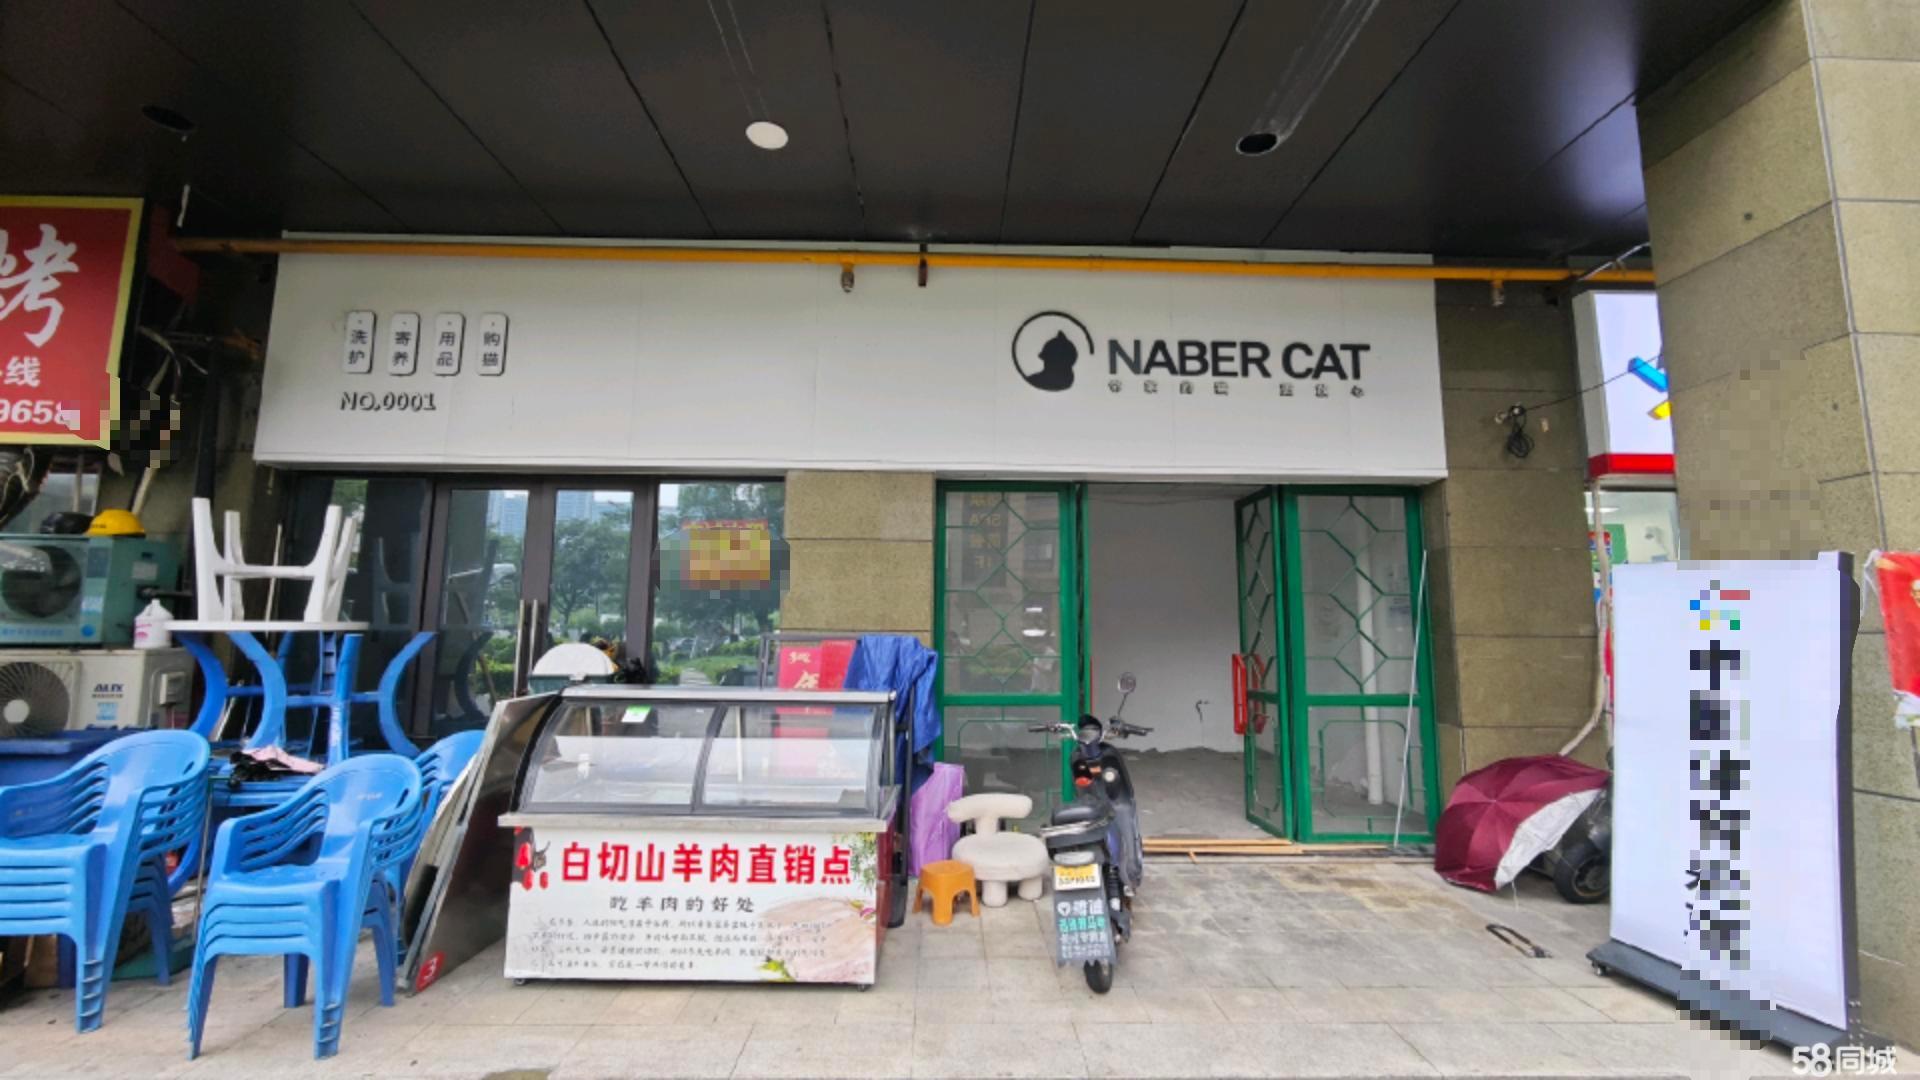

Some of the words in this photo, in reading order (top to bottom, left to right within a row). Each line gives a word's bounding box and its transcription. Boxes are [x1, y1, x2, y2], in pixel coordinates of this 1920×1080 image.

[348, 329, 368, 365] 洗护
[392, 330, 412, 367] 寄养
[436, 331, 456, 367] 用品
[482, 331, 501, 367] 购猫
[1107, 338, 1272, 379] NABER
[1280, 341, 1371, 381] CAT
[0, 355, 41, 388] 线
[562, 841, 851, 885] 白切山羊肉直销点
[609, 895, 755, 913] 吃羊肉的好处
